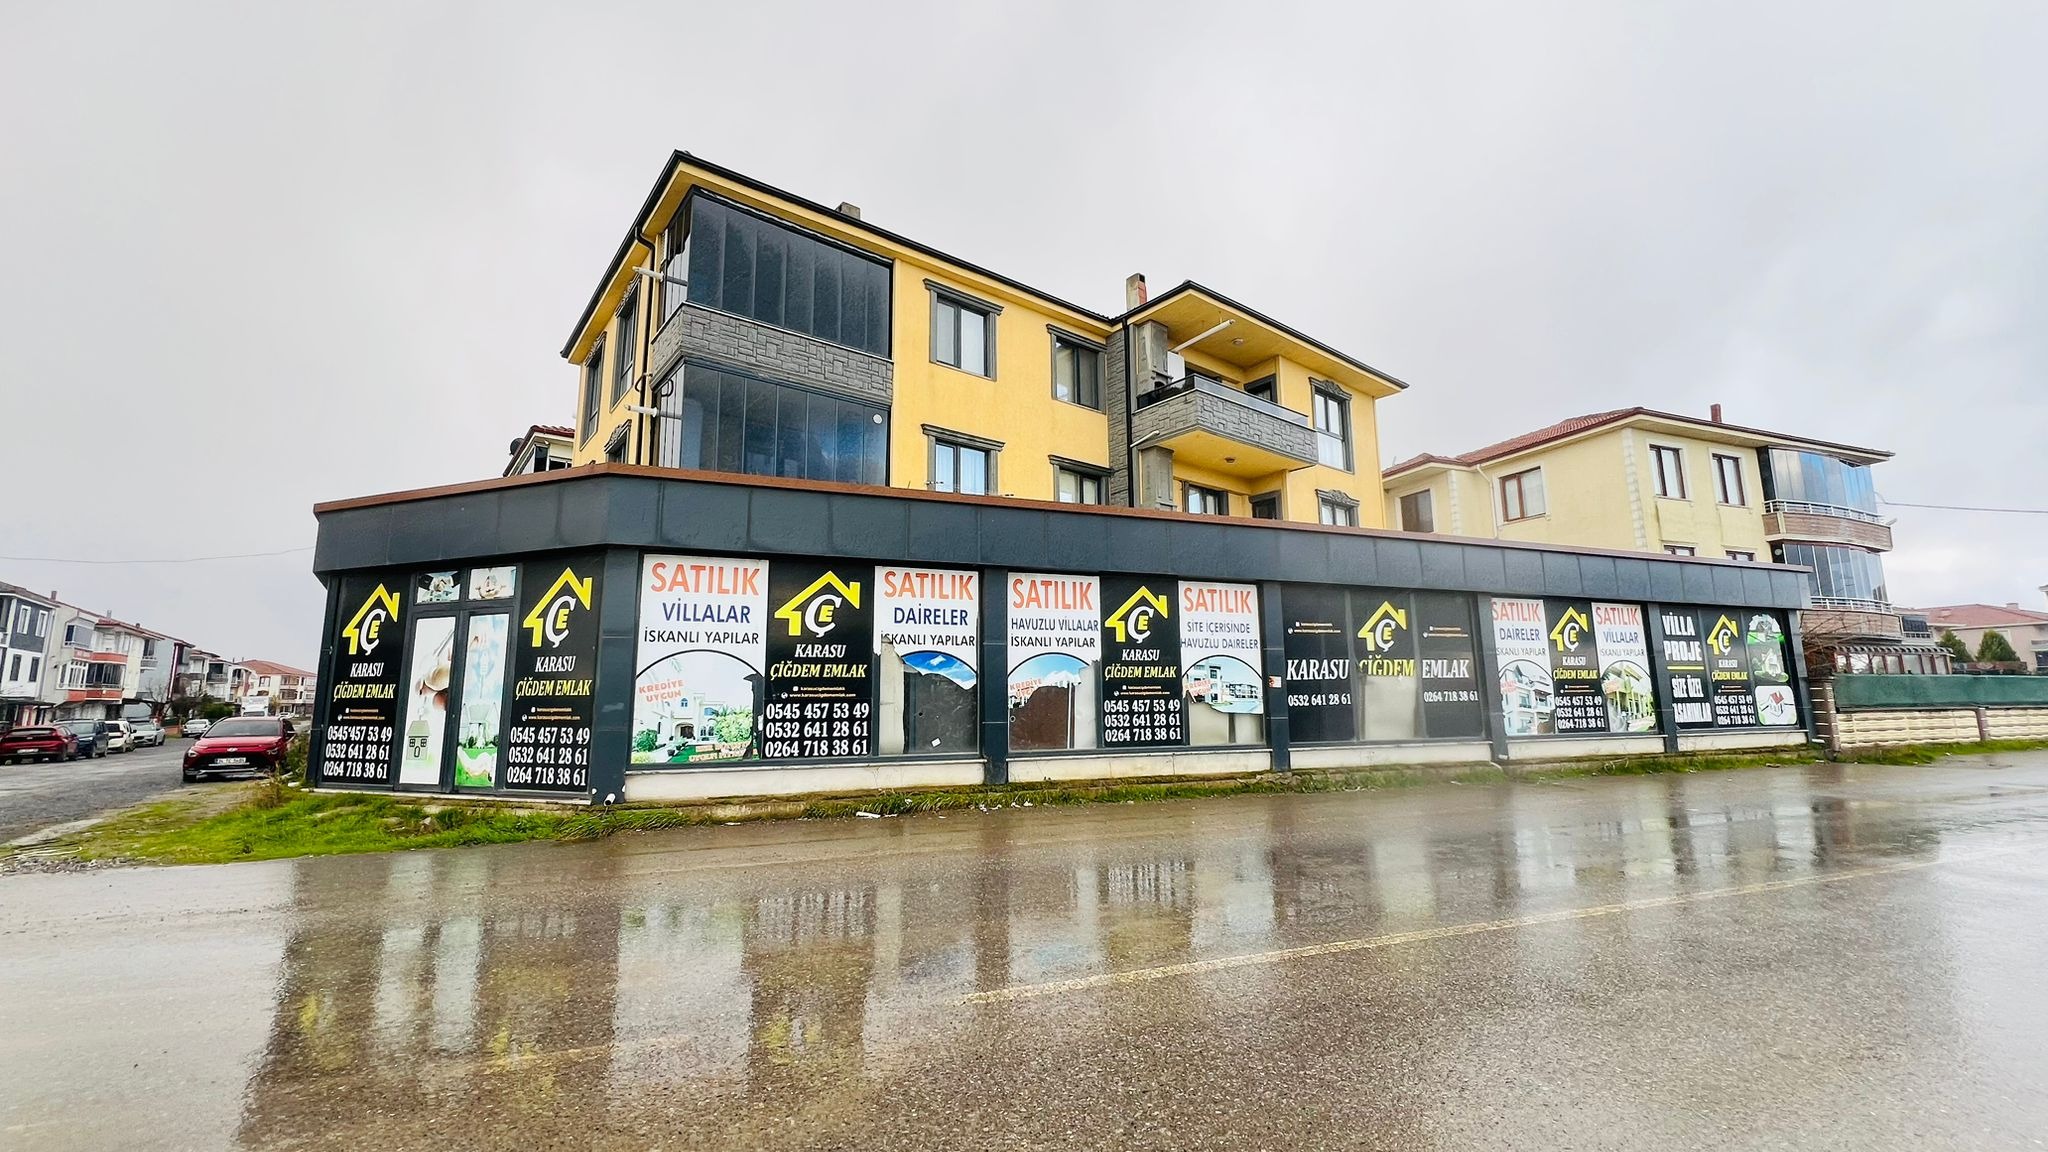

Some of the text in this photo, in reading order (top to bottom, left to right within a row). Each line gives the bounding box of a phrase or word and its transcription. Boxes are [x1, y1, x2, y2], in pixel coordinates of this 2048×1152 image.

[651, 562, 761, 596] SATILIK
[884, 571, 974, 600] SATILIK
[1012, 579, 1093, 610] SATILIK
[1184, 587, 1252, 613] SATILIK
[663, 598, 751, 624] VİLLALAR
[894, 604, 968, 626] DAİRELER
[1492, 602, 1541, 622] SATILIK
[1595, 606, 1640, 625] SATILIK
[1011, 616, 1099, 631] HAVUZLU VİLLALAR
[1187, 619, 1250, 635] SİTE İÇERİSİNDE
[1662, 612, 1696, 636] VİLLA
[644, 627, 759, 644] İSKANLI YAPILAR
[930, 634, 975, 646] YAPILAR
[1011, 633, 1095, 648] İSKANLI YAPILAR
[1500, 625, 1540, 641] DAİRELER
[1603, 628, 1639, 643] VİLLALAR
[1181, 636, 1258, 649] HAVUZLU DAİRELER
[794, 644, 846, 658] KARASU
[1122, 649, 1160, 661] KARASU
[1522, 648, 1546, 656] YAPILAR
[1663, 641, 1702, 661] PROJE
[535, 656, 576, 672] KARASU
[1287, 659, 1349, 680] KARASU
[1422, 659, 1469, 678] EMLAK
[1562, 657, 1586, 666] KARASU
[350, 663, 384, 678] KARASU
[770, 662, 867, 680] ÇİĞDEM EMLAK
[1105, 664, 1176, 680] ÇİĞDEM EMLAK
[1577, 669, 1598, 679] EMLAK
[333, 683, 396, 702] ÇİĞDEM EMLAK
[516, 677, 592, 700] ÇİĞDEM EMLAK
[639, 679, 684, 694] KREDİYE
[646, 690, 682, 703] UYGUN
[1288, 693, 1351, 706] 0532 641 28 61
[1424, 690, 1478, 703] 0264 718 38 61
[766, 703, 870, 719] 0545 457 53 49
[1104, 699, 1181, 712] 0545 457 53 49
[1105, 713, 1181, 727] 0532 641 28 61
[328, 725, 392, 742] 0545 457 53 49
[510, 726, 590, 745] 0545 457 53 49
[766, 721, 868, 738] 0532 641 28 61
[1105, 728, 1181, 742] 0264 718 38 61
[325, 744, 390, 760] 0532 641 28 61
[509, 746, 587, 766] 0532 641 28 61
[765, 742, 799, 758] 0264
[803, 741, 828, 757] 718
[832, 741, 849, 755] 38
[852, 739, 868, 755] 61
[323, 762, 387, 779] 0264 718 38 61
[507, 767, 586, 786] 0264 718 38 61
